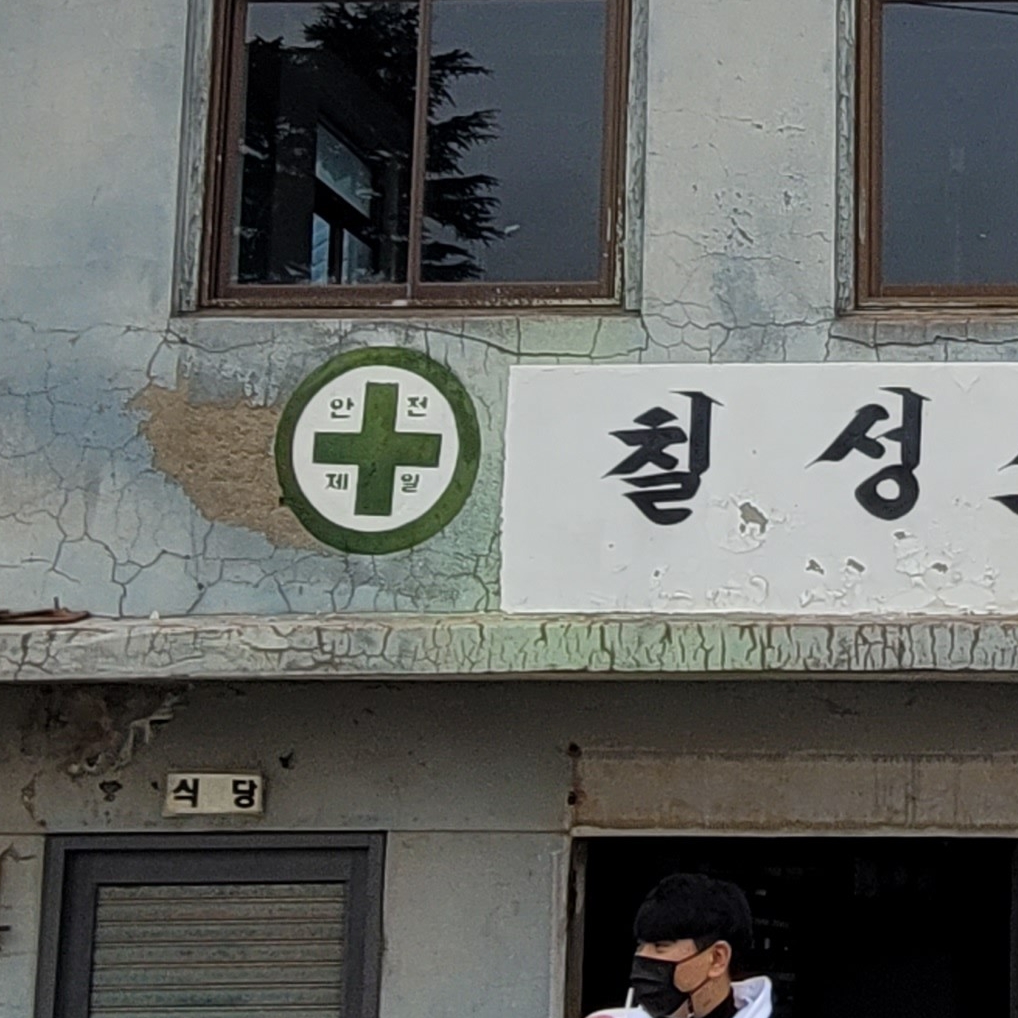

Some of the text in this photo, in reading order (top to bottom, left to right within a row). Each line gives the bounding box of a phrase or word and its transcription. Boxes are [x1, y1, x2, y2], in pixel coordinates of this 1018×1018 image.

[329, 396, 428, 419] 안전
[325, 473, 420, 493] 제일
[172, 778, 258, 809] 식당
